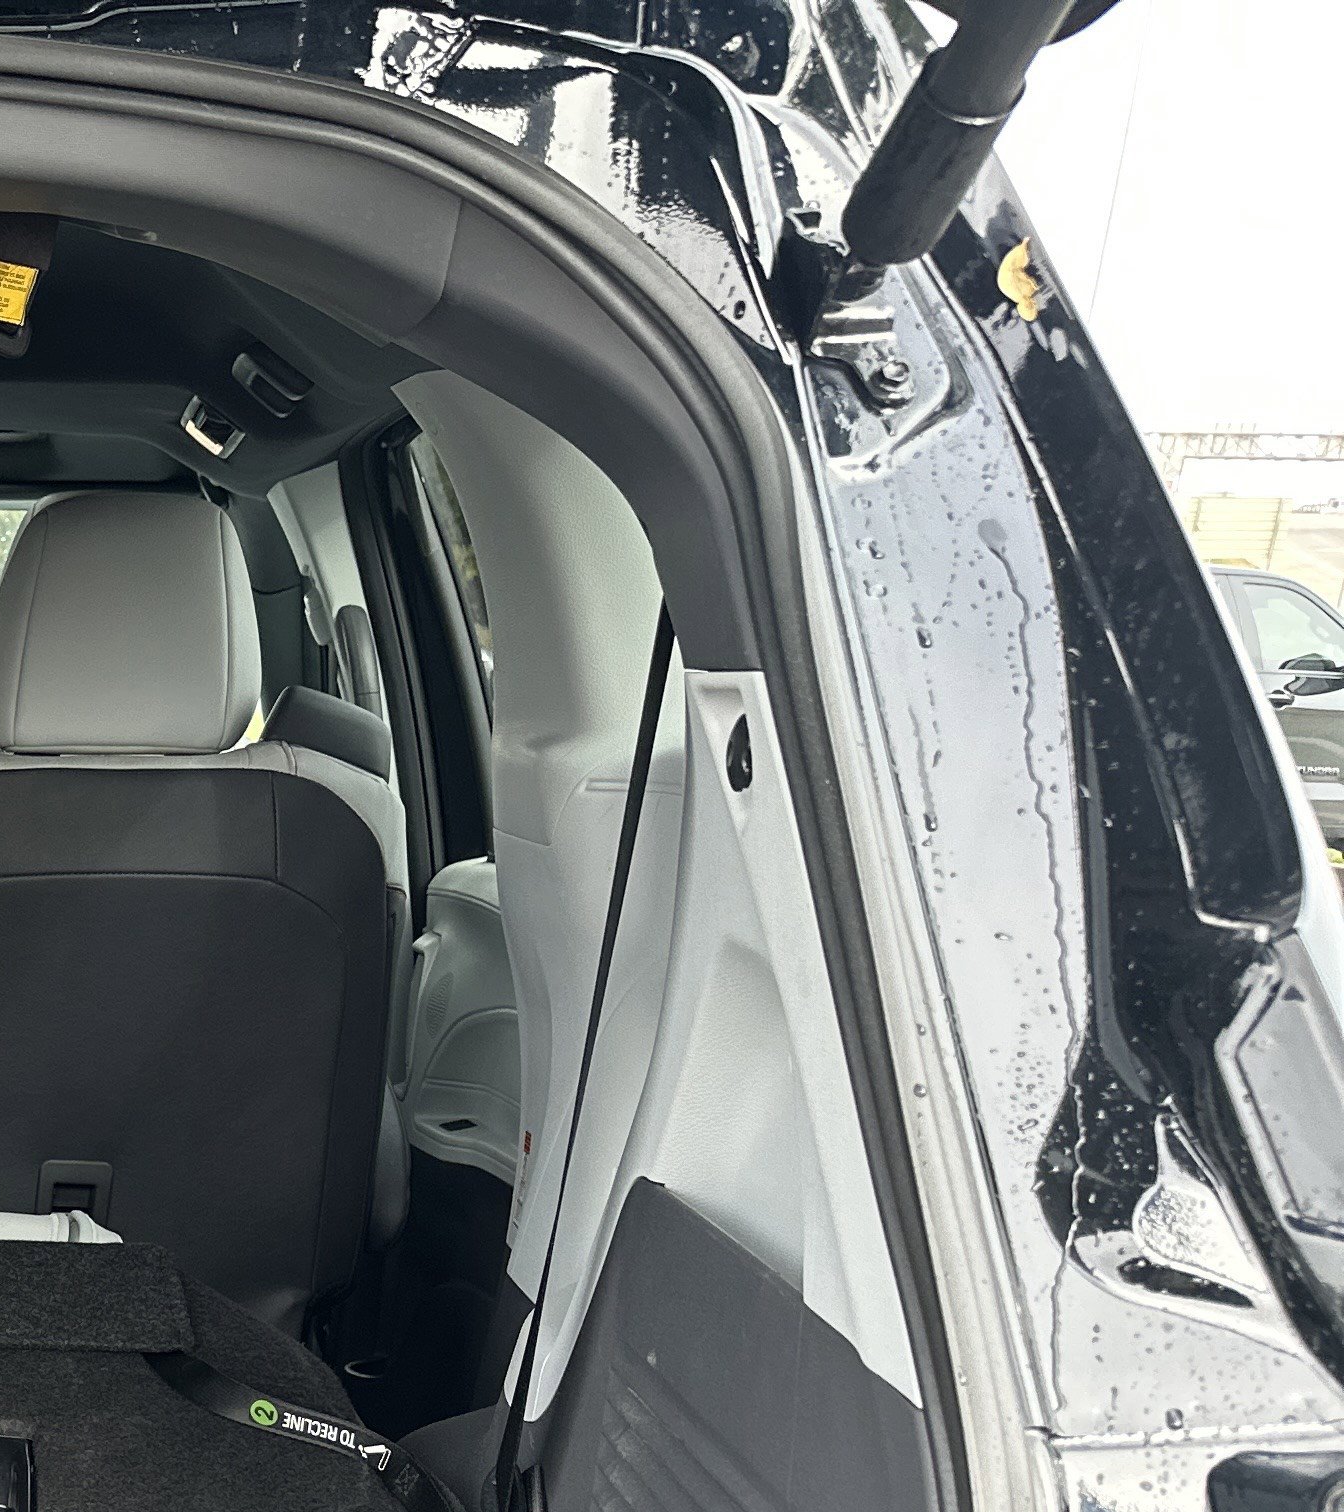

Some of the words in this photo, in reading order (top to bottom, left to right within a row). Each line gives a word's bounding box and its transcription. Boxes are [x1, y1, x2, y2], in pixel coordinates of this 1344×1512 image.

[254, 1406, 275, 1421] 2
[282, 1412, 339, 1442] RECLINE
[339, 1429, 356, 1448] TO
